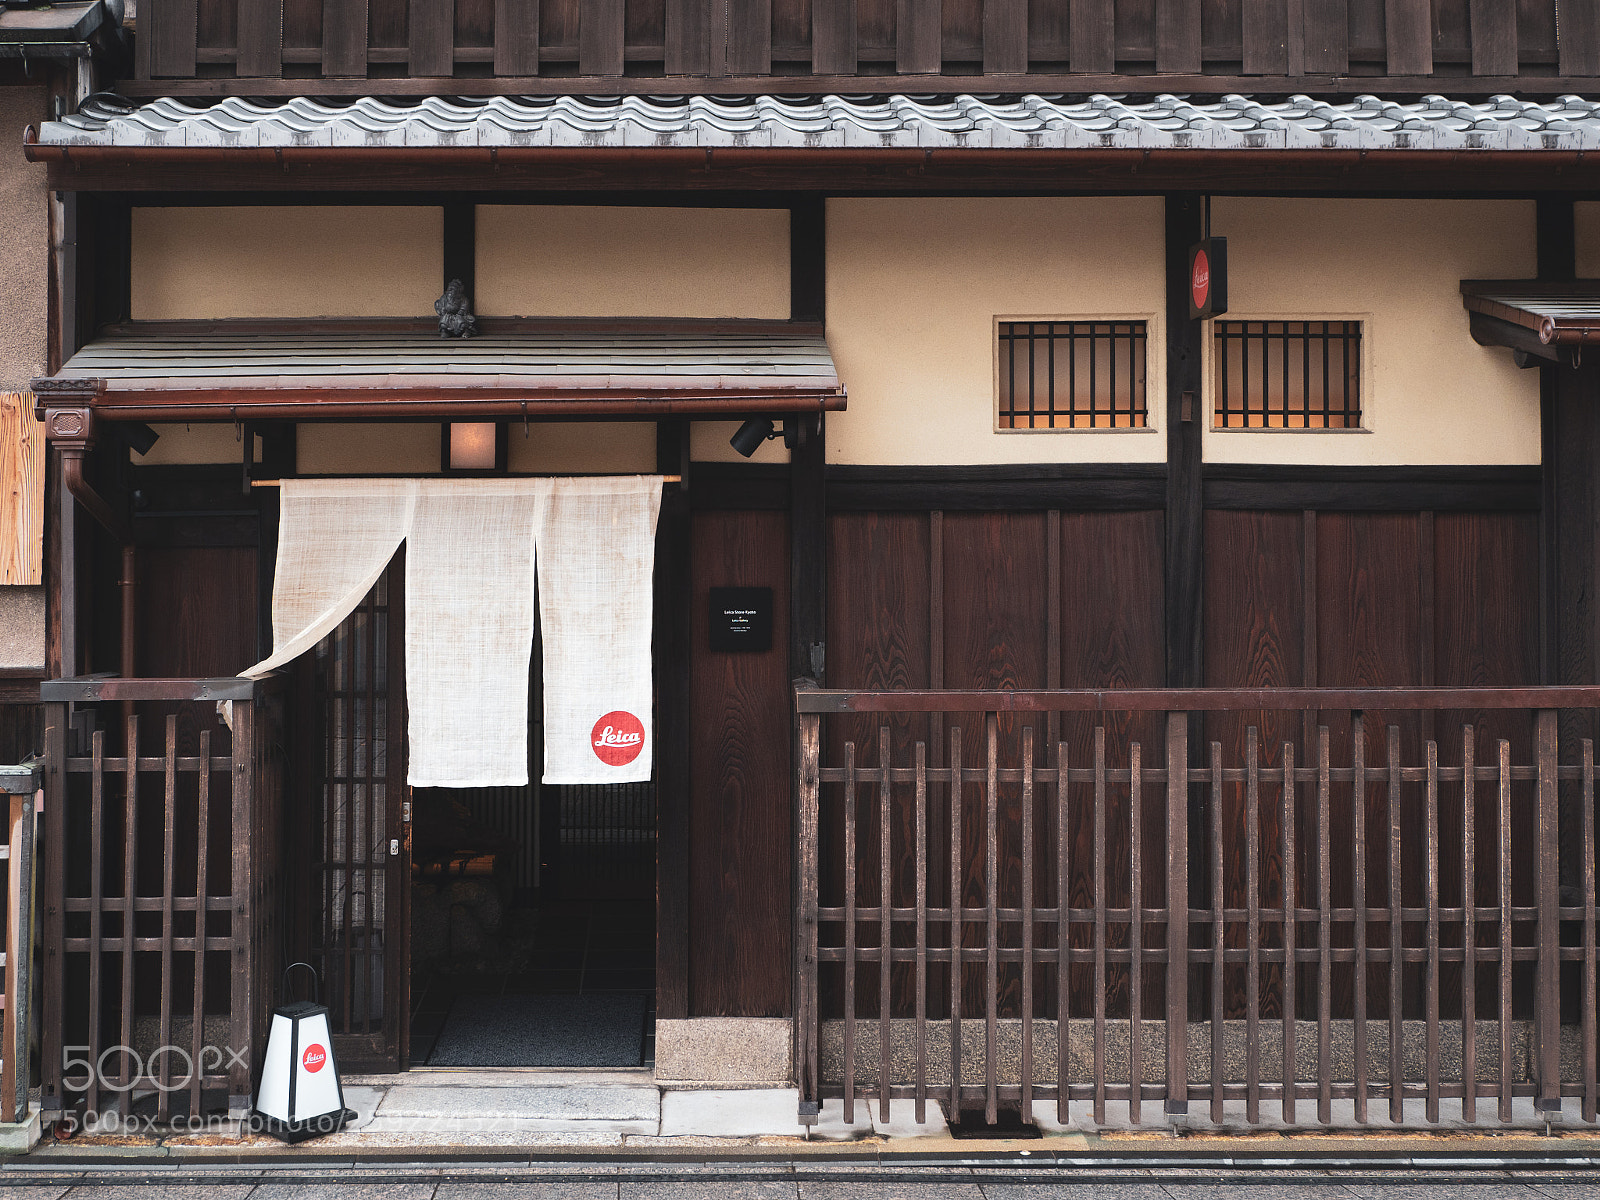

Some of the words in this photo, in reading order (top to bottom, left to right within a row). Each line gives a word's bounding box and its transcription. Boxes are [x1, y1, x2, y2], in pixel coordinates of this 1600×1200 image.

[1194, 266, 1209, 288] Leica
[594, 725, 642, 748] Leica
[303, 1052, 325, 1065] Leica
